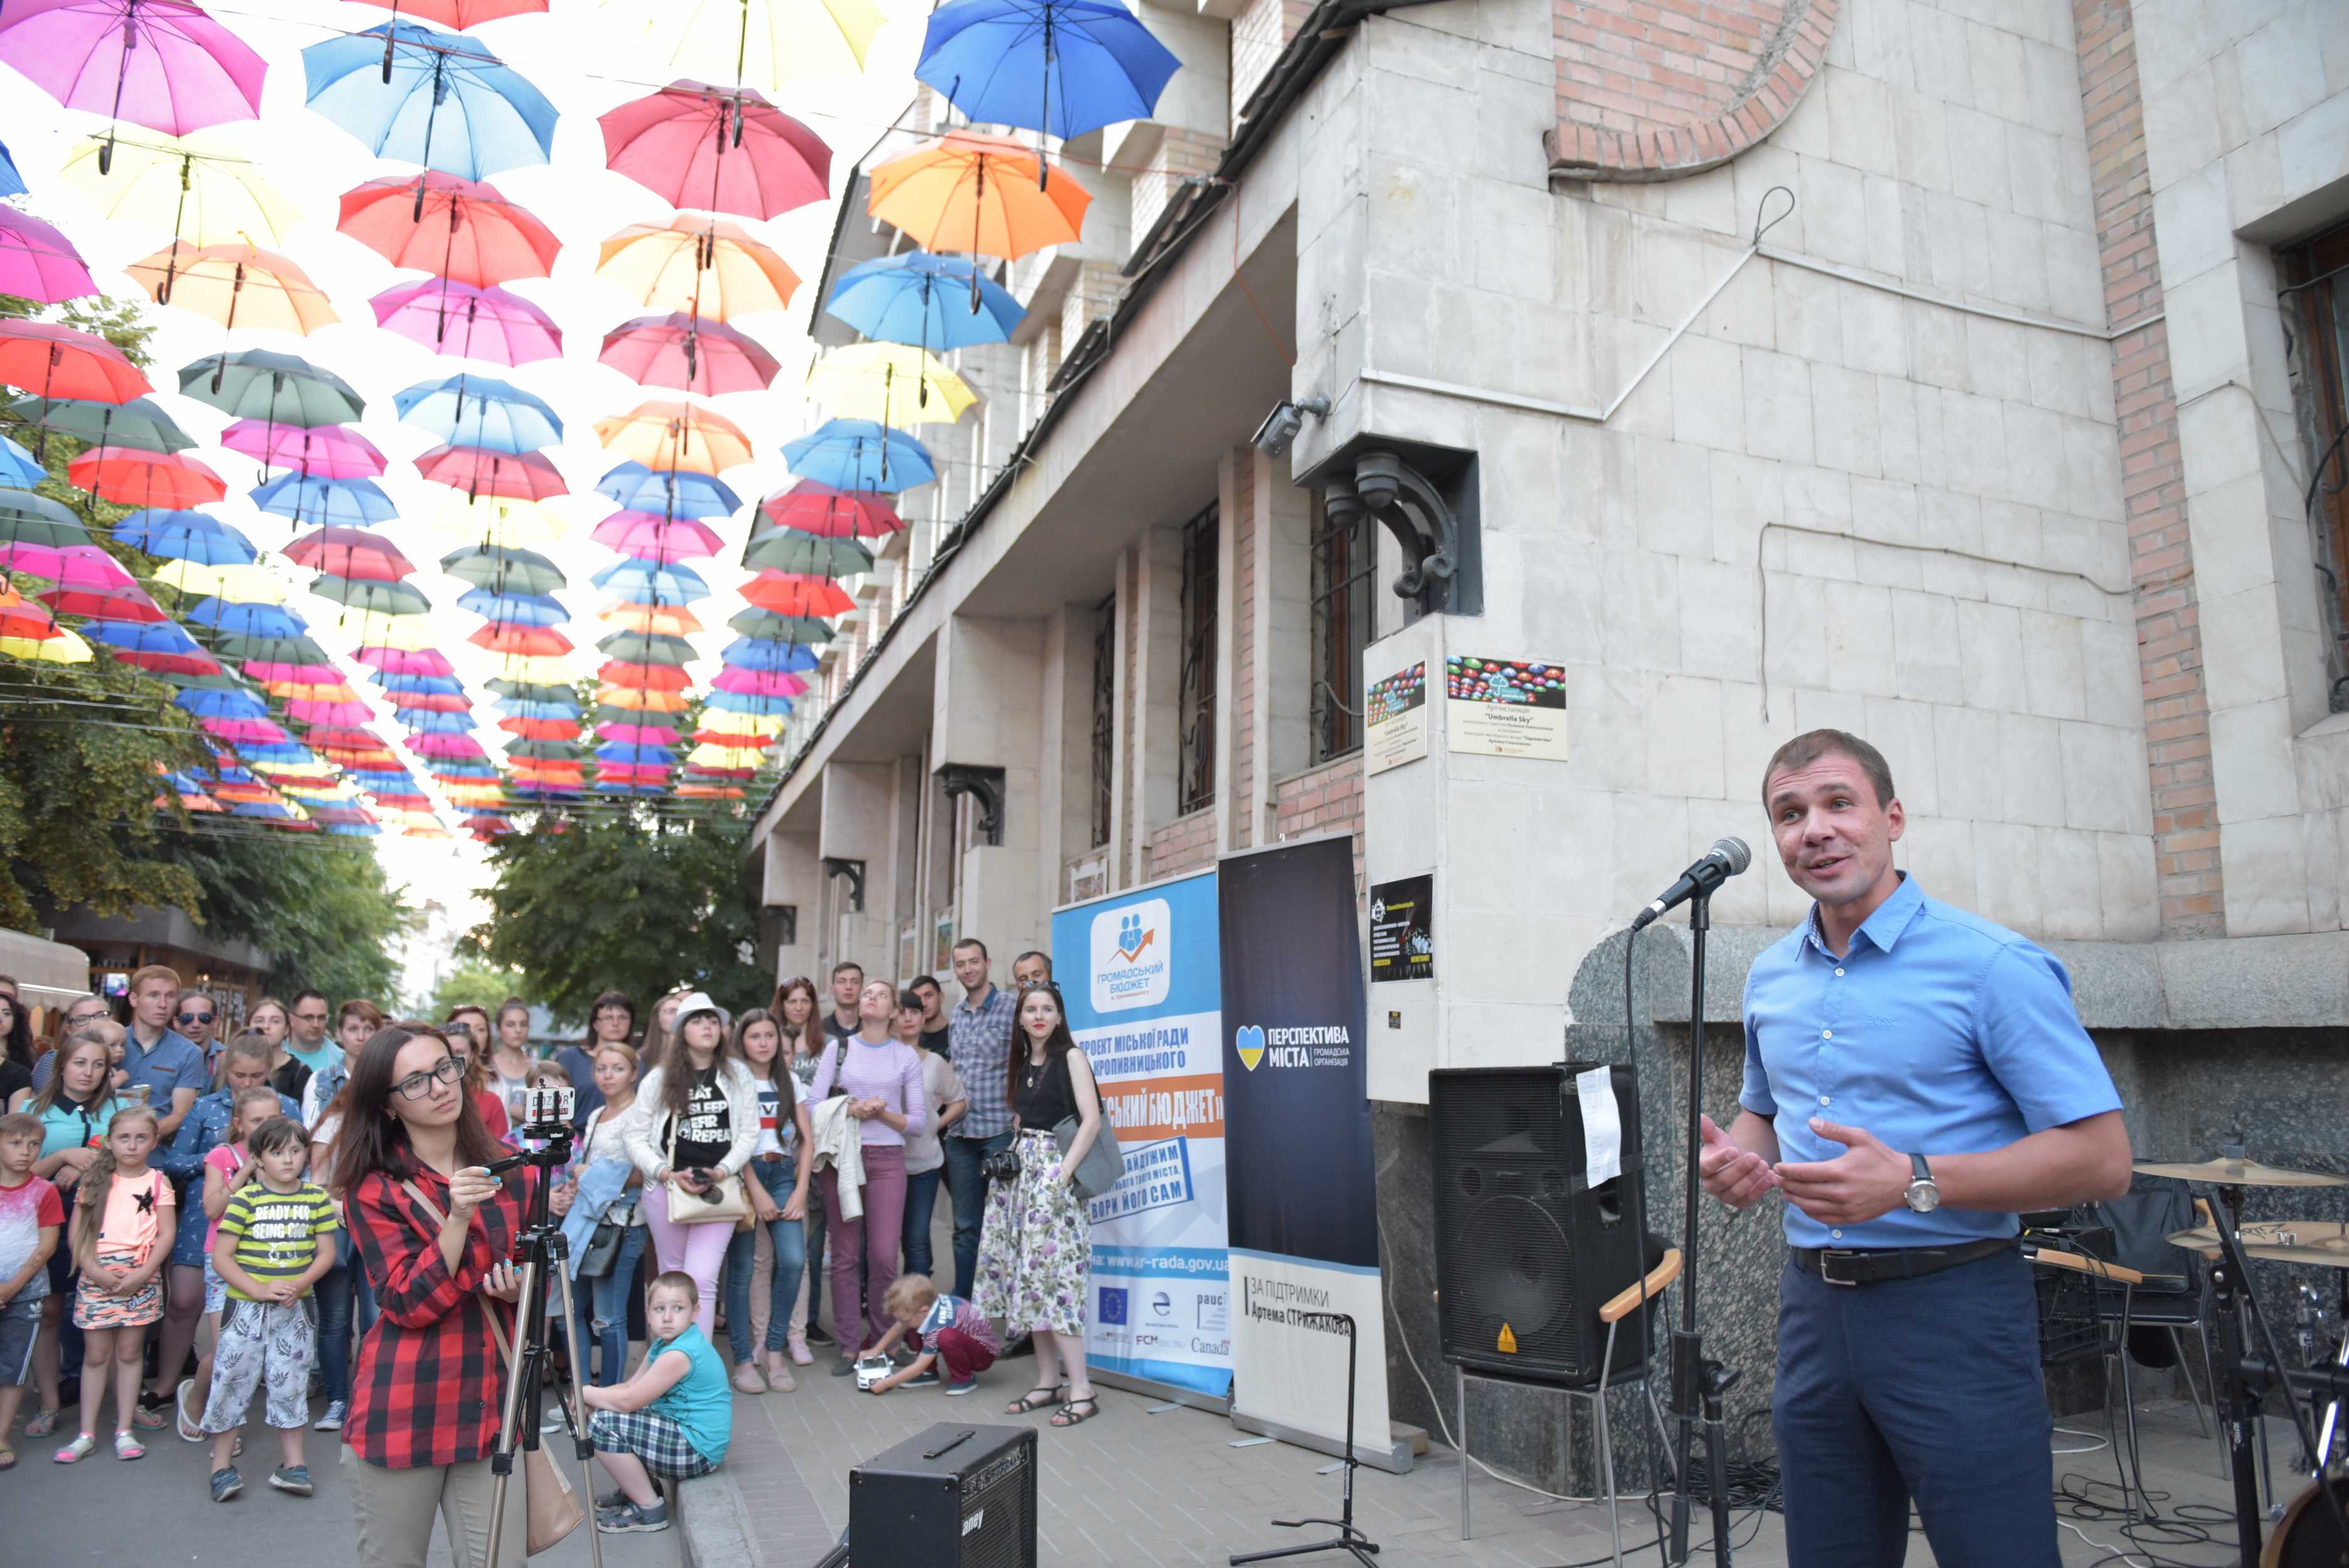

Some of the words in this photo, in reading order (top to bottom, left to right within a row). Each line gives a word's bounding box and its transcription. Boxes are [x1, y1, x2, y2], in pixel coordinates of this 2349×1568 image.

[1097, 960, 1164, 984] ГРОМАДСЬКИЙ
[1110, 978, 1150, 993] БЮДЖЕТ
[1114, 1029, 1156, 1054] МІСЬКОЇ
[1157, 1027, 1189, 1048] РАДИ
[1268, 1025, 1350, 1046] ПЕРСПЕКТИВА
[1269, 1047, 1310, 1067] МІСТА
[1313, 1047, 1350, 1057] ГРОМАДСЬКА
[687, 1100, 728, 1115] SLEEP
[691, 1127, 731, 1143] REPEA
[1126, 1145, 1179, 1173] АЙДУЖИМ
[1091, 1197, 1118, 1219] ВОРИ
[1150, 1180, 1182, 1203] САМ
[255, 1204, 291, 1221] READY
[252, 1222, 285, 1240] BEING
[1251, 1277, 1264, 1296] ЗА
[1266, 1280, 1330, 1309] ПІДТРИМКИ
[1252, 1301, 1285, 1323] Артема
[1136, 1335, 1158, 1346] FCM
[1191, 1337, 1229, 1356] Canada
[962, 1508, 984, 1537] aney
